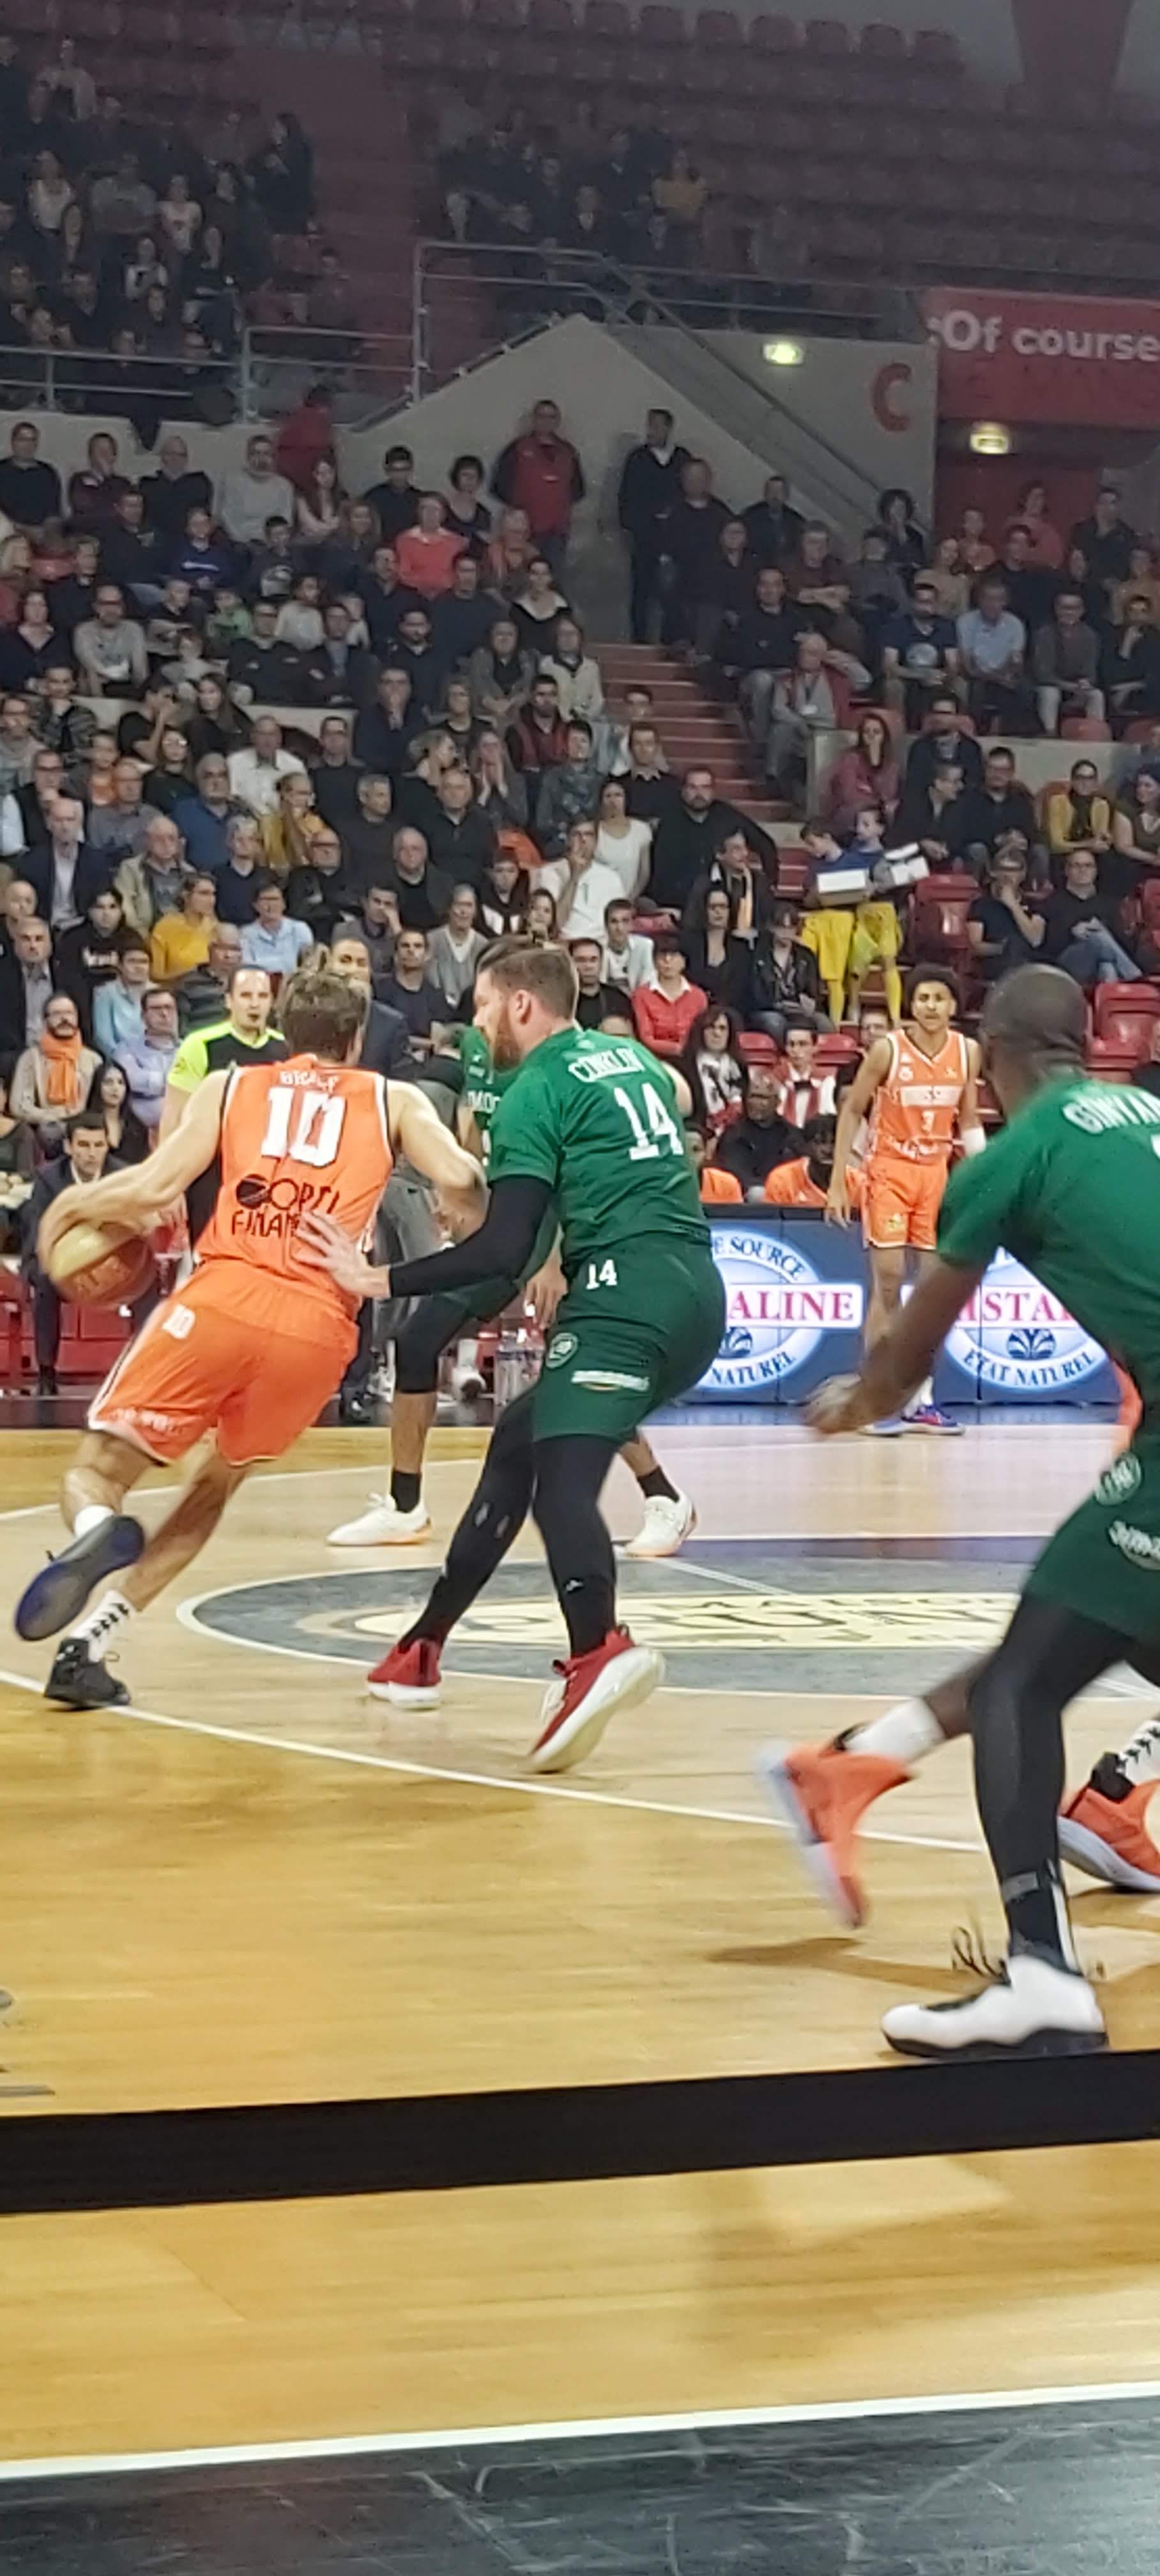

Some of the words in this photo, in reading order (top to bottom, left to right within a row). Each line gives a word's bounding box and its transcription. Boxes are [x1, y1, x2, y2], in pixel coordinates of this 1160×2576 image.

[1011, 327, 1160, 362] course
[869, 362, 912, 433] C
[261, 1086, 347, 1168] 10
[613, 1082, 684, 1161] 14
[585, 1259, 618, 1290] 14
[731, 1236, 806, 1279] SOURCE
[729, 1290, 853, 1321] ALINE
[711, 1351, 796, 1384] NATUREL
[1014, 1349, 1095, 1386] NATUREL
